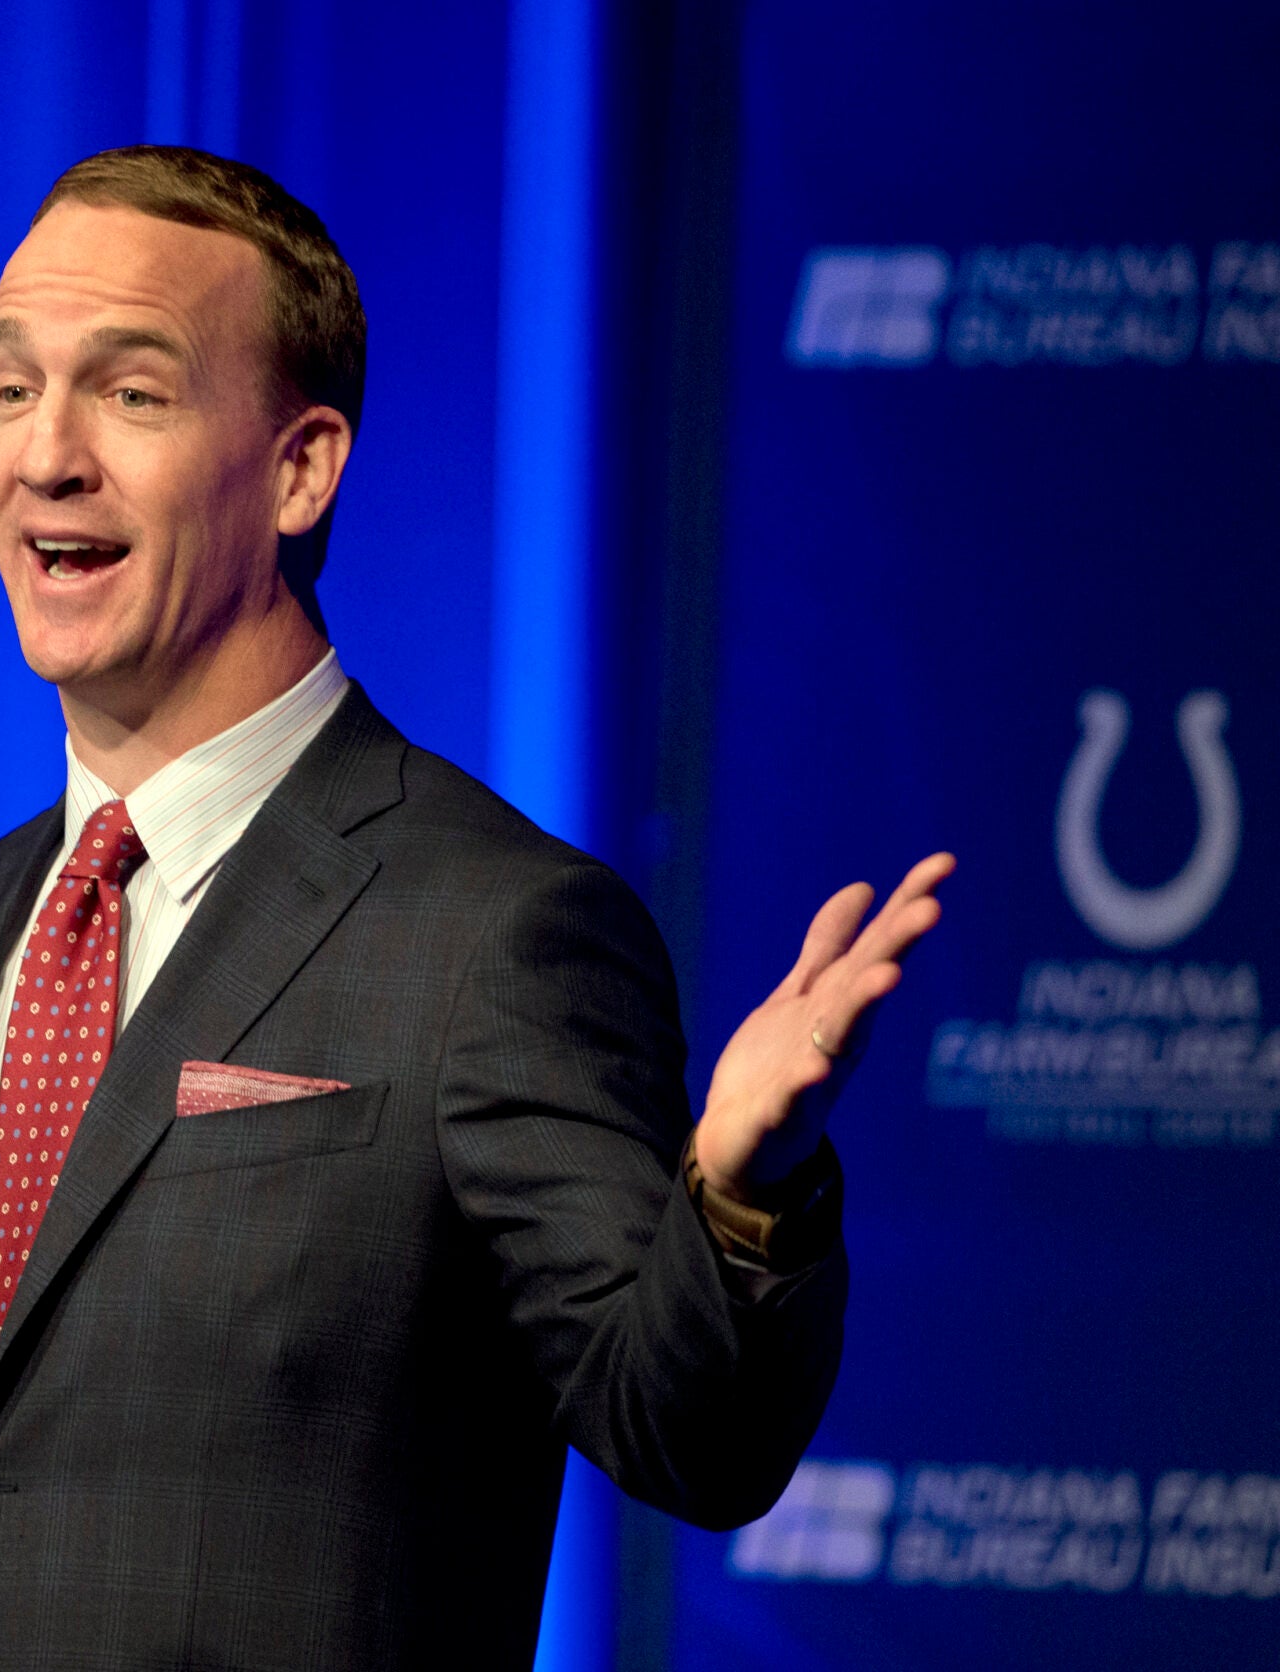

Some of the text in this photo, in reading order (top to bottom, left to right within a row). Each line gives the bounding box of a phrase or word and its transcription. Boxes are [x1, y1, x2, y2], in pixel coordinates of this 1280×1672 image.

[958, 244, 1196, 302] INDIANA
[949, 303, 1196, 364] BUREAU
[1023, 963, 1258, 1018] INDIANA
[904, 1464, 1139, 1522] INDIANA
[891, 1522, 1138, 1592] BUREAU
